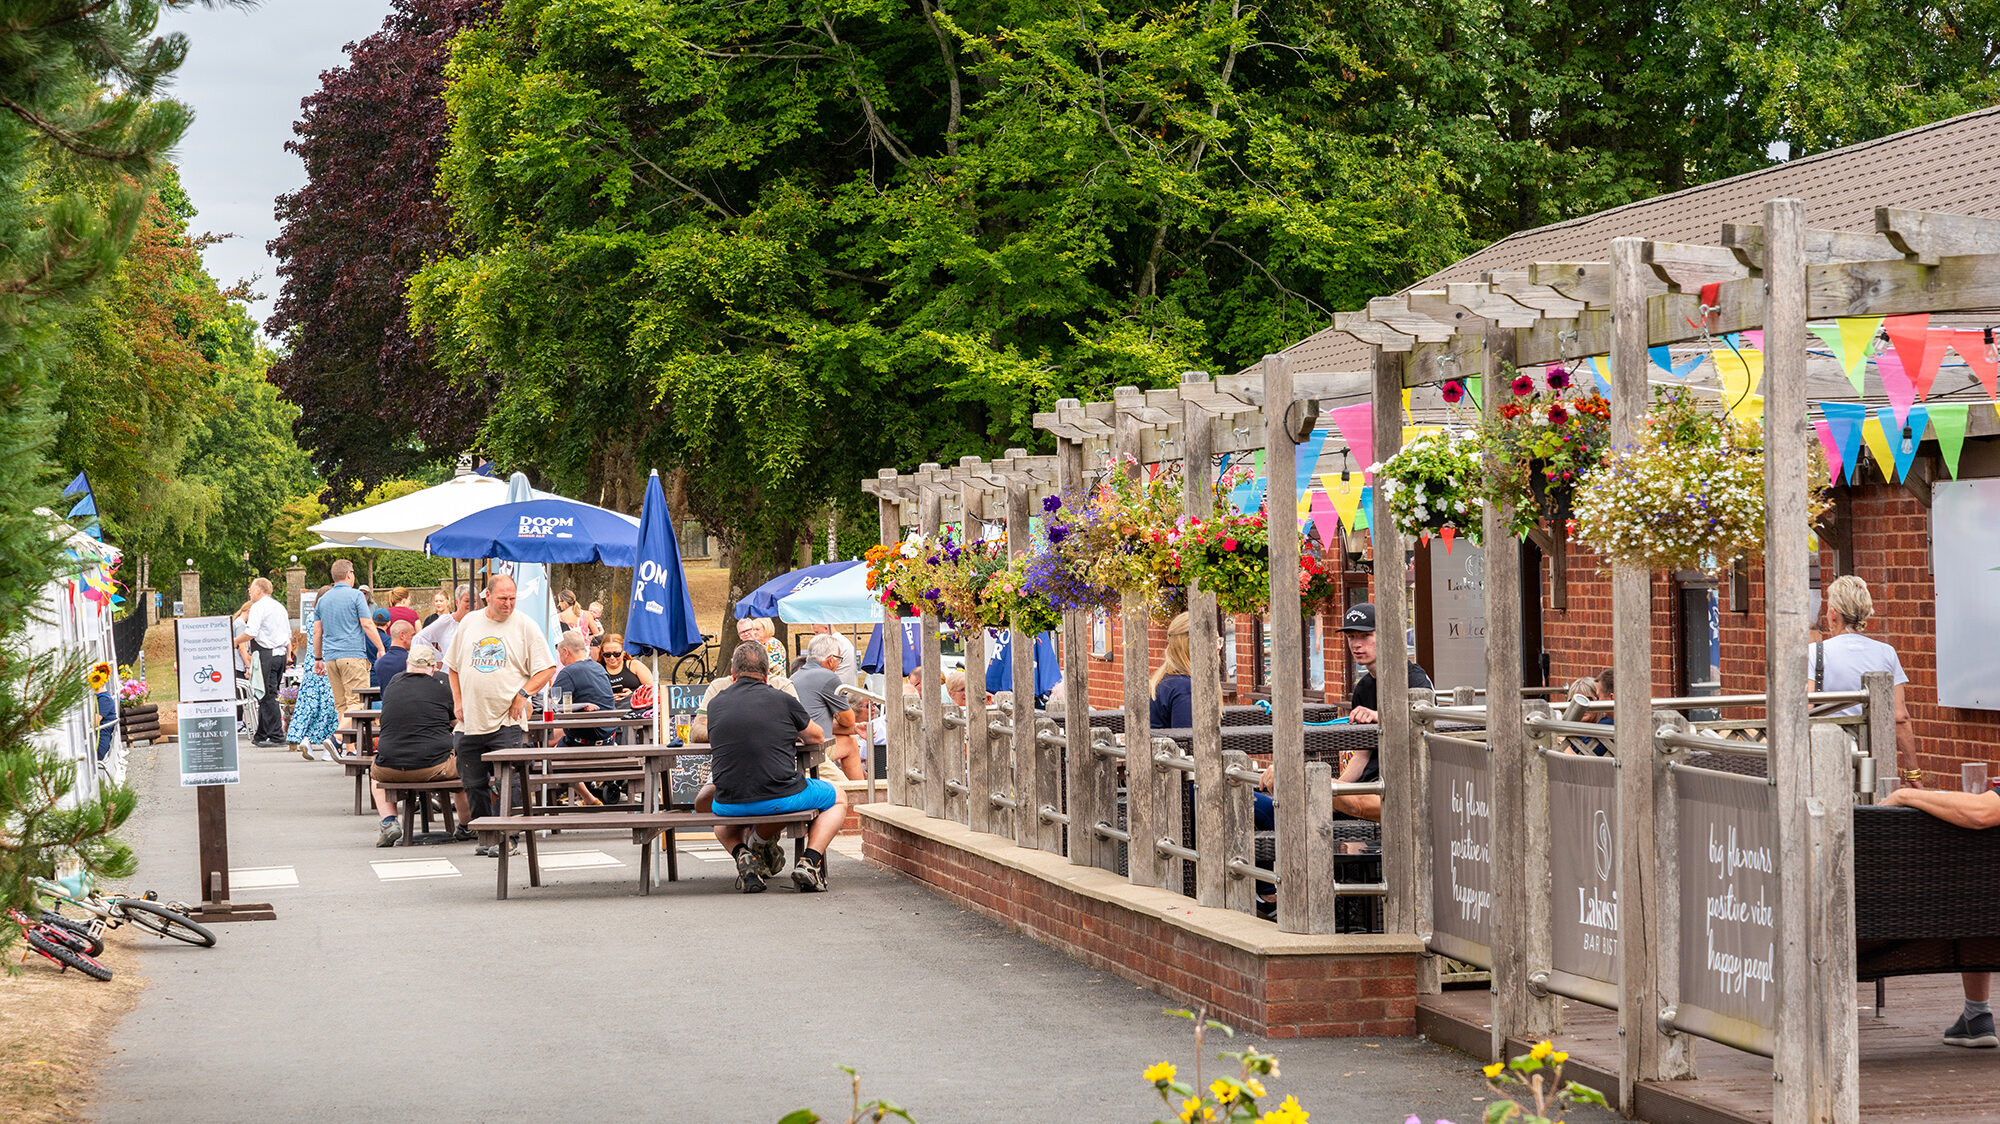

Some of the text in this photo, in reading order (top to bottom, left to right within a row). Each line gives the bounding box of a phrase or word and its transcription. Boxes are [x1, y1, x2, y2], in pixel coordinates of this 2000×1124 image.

[519, 525, 554, 535] BAR
[520, 516, 574, 527] DOOM
[213, 705, 229, 713] Lake
[187, 730, 229, 739] THE LINE UP
[1451, 778, 1464, 826] big
[1709, 822, 1773, 880] big flavours
[1578, 886, 1618, 931] Lakesi
[1706, 883, 1774, 937] positive vibe
[1583, 932, 1618, 957] BAR BIST
[1707, 928, 1774, 1002] happy peopl
